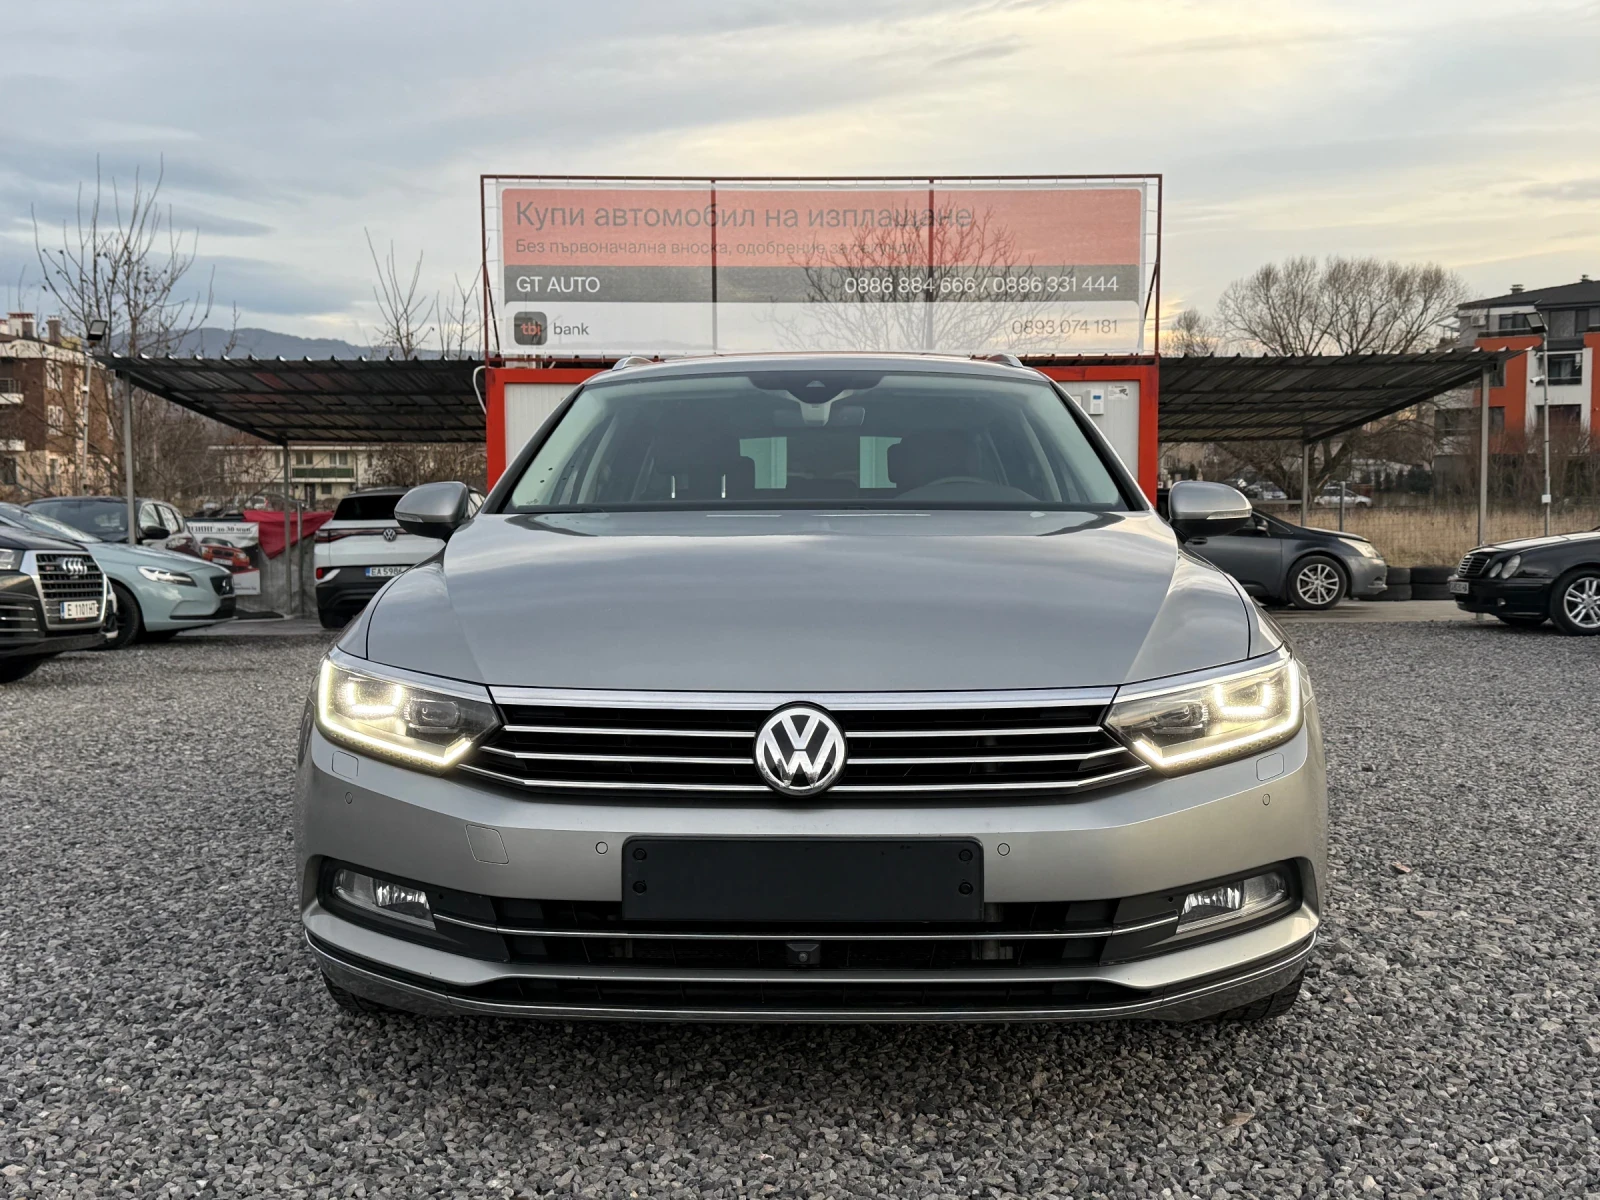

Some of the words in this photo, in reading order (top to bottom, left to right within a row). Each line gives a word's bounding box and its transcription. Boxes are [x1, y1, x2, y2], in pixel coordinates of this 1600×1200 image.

[516, 201, 585, 230] Купи
[594, 203, 755, 228] автомобил
[765, 208, 799, 228] на
[808, 207, 972, 230] изплащане
[515, 239, 546, 254] Без
[550, 240, 666, 257] първоначална
[672, 241, 731, 256] вноска,
[736, 239, 825, 257] одобрение
[516, 276, 543, 293] GT
[547, 276, 600, 293] AUTO
[844, 277, 893, 293] 0886
[898, 277, 935, 293] 884
[940, 277, 976, 293] 666
[992, 276, 1041, 293] 0886
[1046, 276, 1077, 292] 331
[1082, 276, 1119, 292] 444
[521, 322, 542, 336] tbi
[553, 322, 590, 336] bank
[1012, 319, 1055, 334] 0893
[1059, 319, 1089, 334] 074
[1094, 318, 1118, 333] 181
[756, 707, 845, 790] VW
